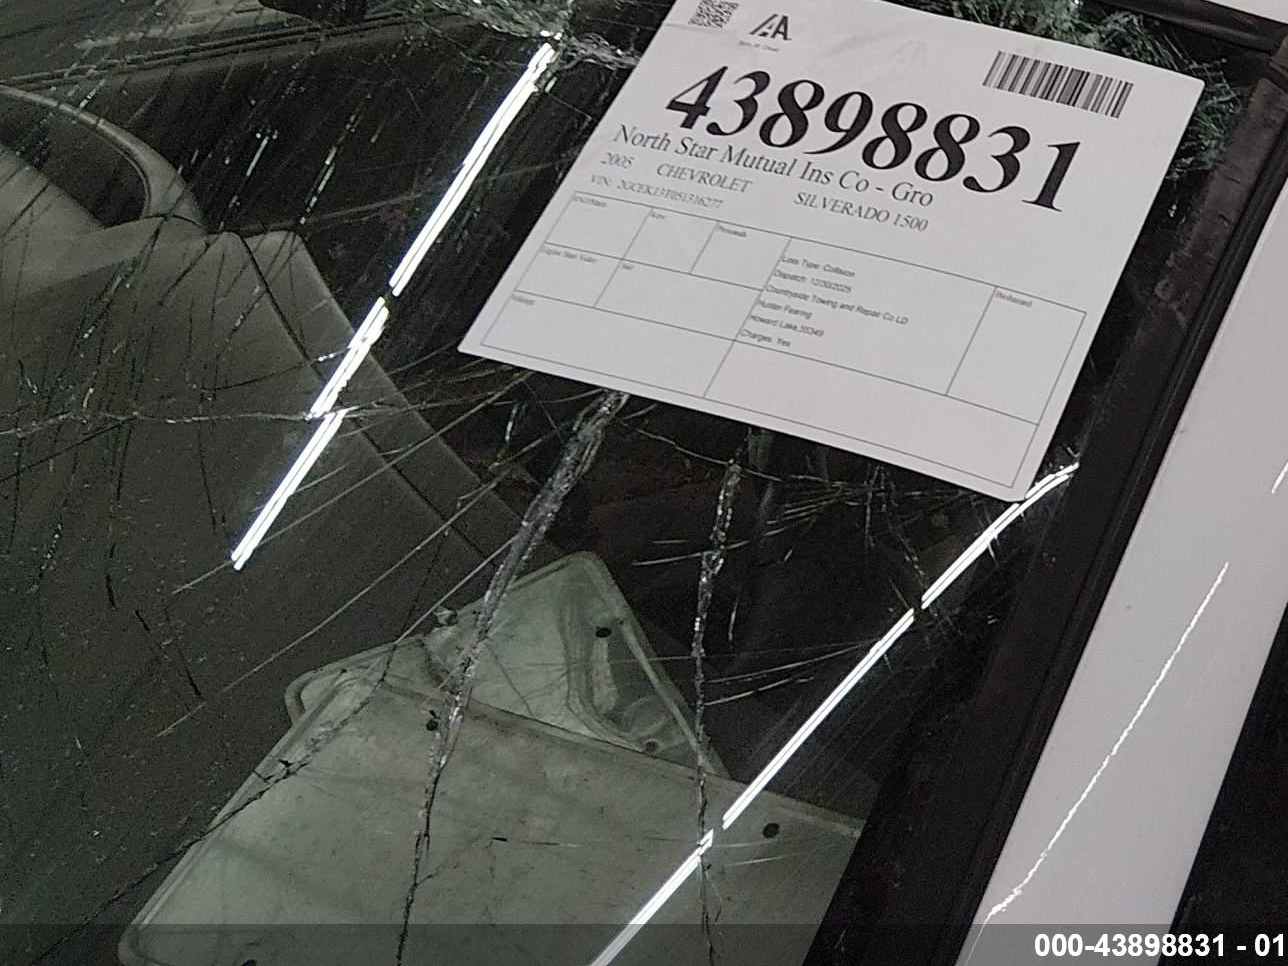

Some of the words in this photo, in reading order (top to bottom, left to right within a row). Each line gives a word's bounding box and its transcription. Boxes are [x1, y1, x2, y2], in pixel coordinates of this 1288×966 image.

[613, 124, 671, 153] North
[675, 136, 718, 161] Star
[720, 144, 798, 177] Mutual
[800, 160, 834, 185] Ins
[839, 169, 870, 193] Co
[891, 181, 934, 207] Gro
[665, 65, 1083, 212] 43898831
[600, 152, 635, 169] 2005
[656, 163, 753, 194] CHEVROLET
[794, 191, 890, 224] SILVERADO
[893, 213, 929, 232] 1500
